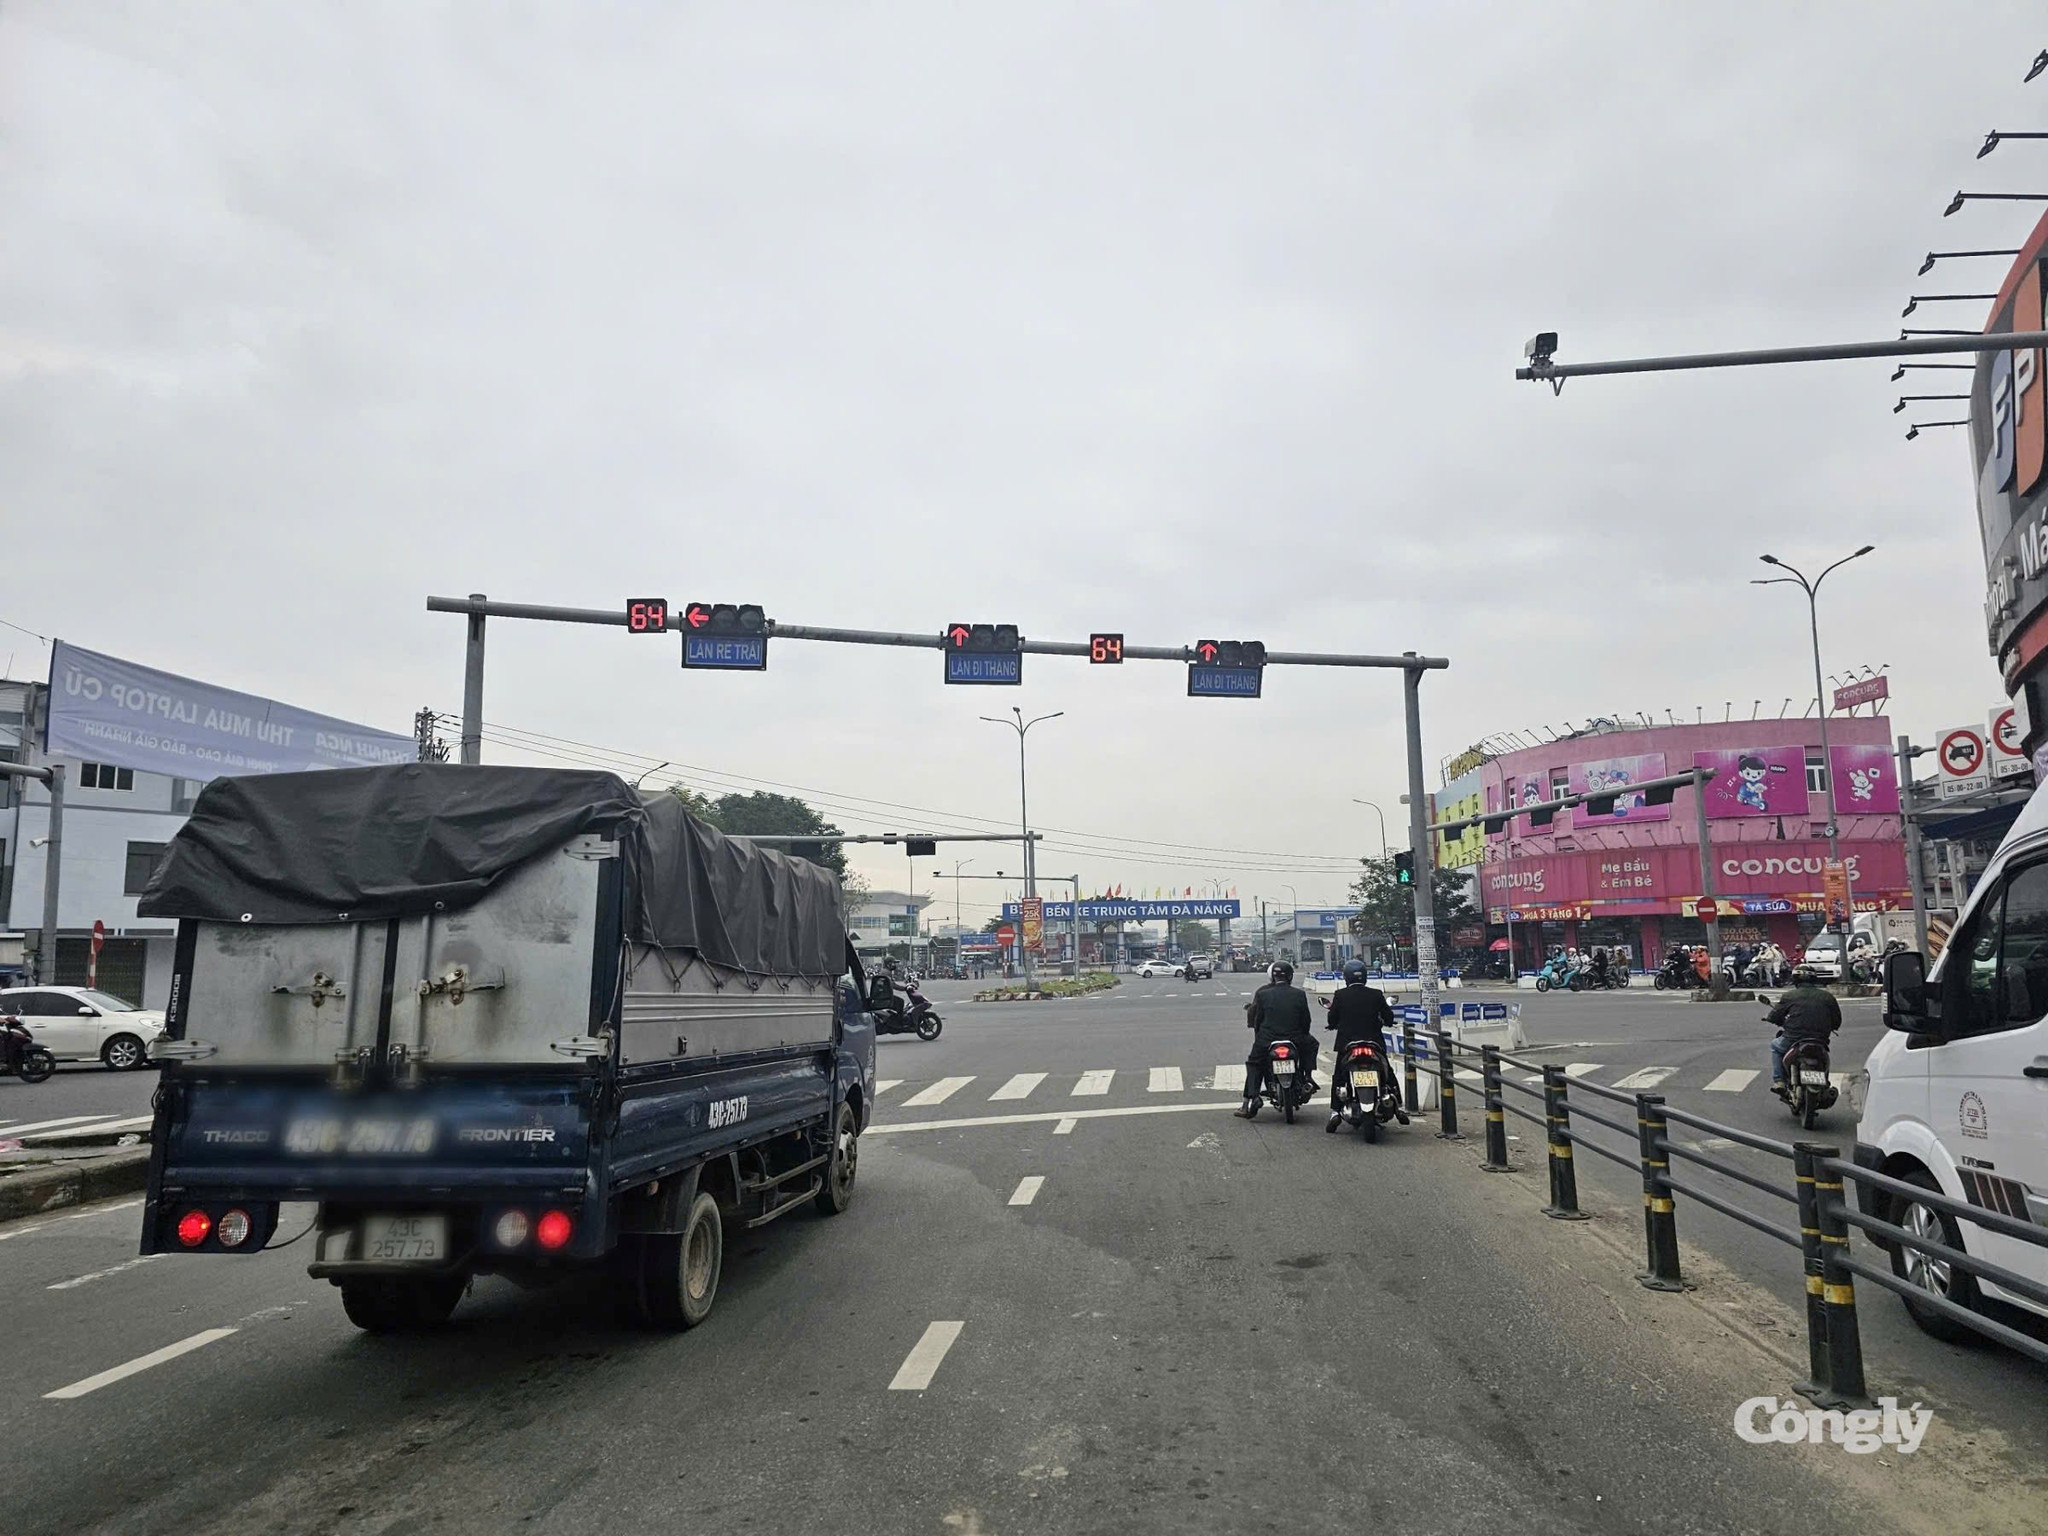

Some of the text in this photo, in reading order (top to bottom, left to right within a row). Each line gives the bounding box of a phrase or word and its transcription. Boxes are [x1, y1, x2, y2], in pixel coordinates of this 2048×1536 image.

[631, 604, 663, 629] 64
[689, 640, 714, 660] LÀN
[735, 641, 760, 662] TRÁI
[1092, 638, 1120, 661] 64
[973, 661, 982, 676] ĐI
[1214, 674, 1224, 689] ĐI
[1602, 858, 1650, 877] Mẹ Bầu
[1722, 854, 1861, 881] concug
[1600, 874, 1653, 888] & Em Bé
[1046, 903, 1070, 917] BẾN
[1092, 906, 1137, 917] TRUNG
[1139, 903, 1168, 916] TÂM
[1171, 902, 1191, 915] ĐÀ
[1194, 901, 1233, 915] NẴNG
[1540, 908, 1546, 919] 3
[1574, 906, 1582, 918] 1
[1796, 901, 1826, 912] MUA
[1879, 899, 1886, 912] 1
[708, 1095, 748, 1129] 43C-257.73
[204, 1130, 268, 1142] THACO
[458, 1127, 555, 1143] FRONTIER
